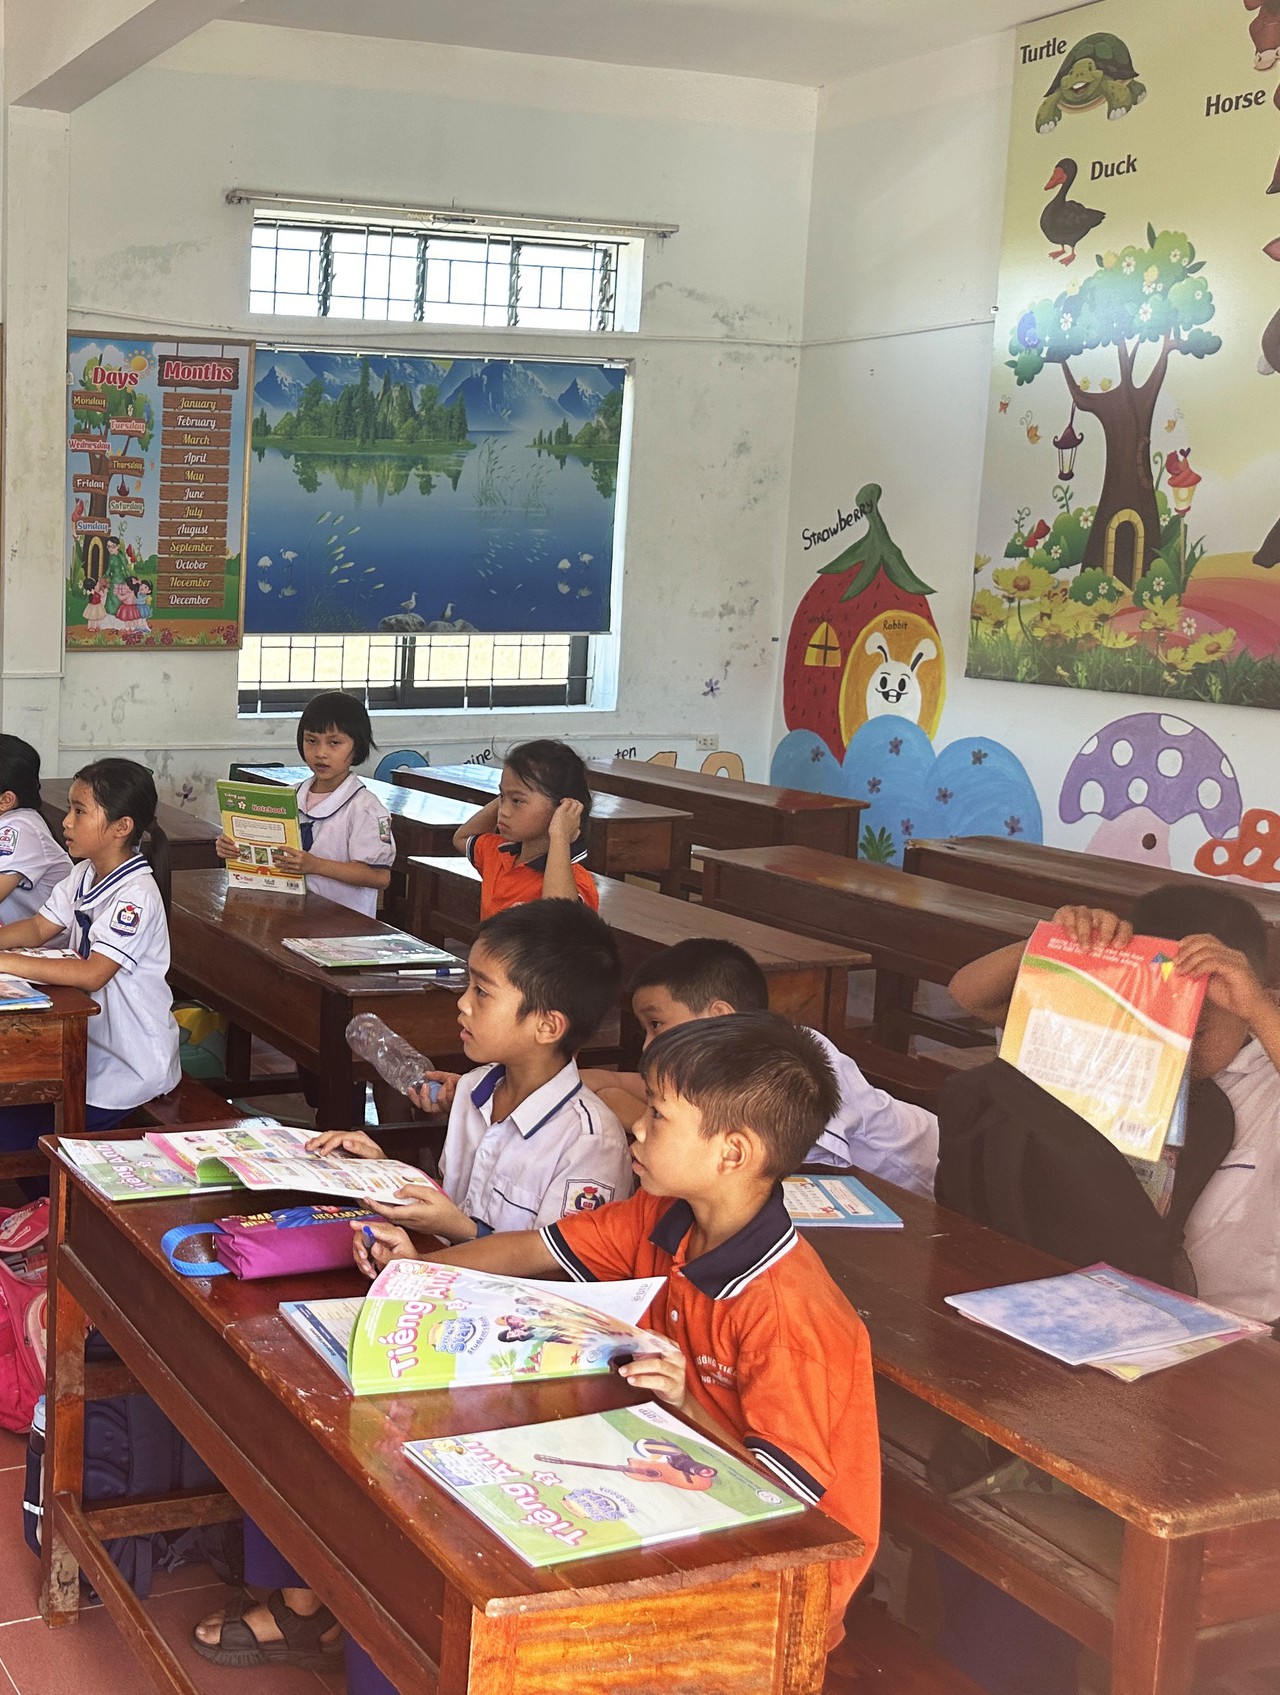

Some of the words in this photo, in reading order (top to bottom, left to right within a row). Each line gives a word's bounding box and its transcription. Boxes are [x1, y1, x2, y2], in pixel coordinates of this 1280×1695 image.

[1020, 37, 1067, 64] Turtle
[1205, 89, 1266, 117] Horse
[1090, 154, 1137, 181] Duck
[92, 366, 138, 389] Days
[164, 361, 232, 382] Months
[73, 396, 106, 410] Monday
[177, 397, 216, 411] January
[110, 419, 146, 433] Tuesday
[176, 415, 216, 429] February
[68, 439, 111, 452] Wednesday
[182, 433, 210, 446] March
[183, 452, 207, 464] April
[112, 459, 143, 471] Thursday
[184, 469, 204, 483] May
[76, 478, 104, 490] Friday
[183, 488, 204, 500] June
[109, 501, 143, 513] Saturday
[183, 505, 203, 519] July
[76, 521, 108, 533] Sunday
[176, 523, 208, 536] August
[170, 541, 214, 553] September
[175, 559, 207, 571] October
[170, 576, 211, 588] November
[169, 594, 211, 605] December
[377, 1301, 436, 1378] Tiếng
[498, 1481, 588, 1547] Tiếng
